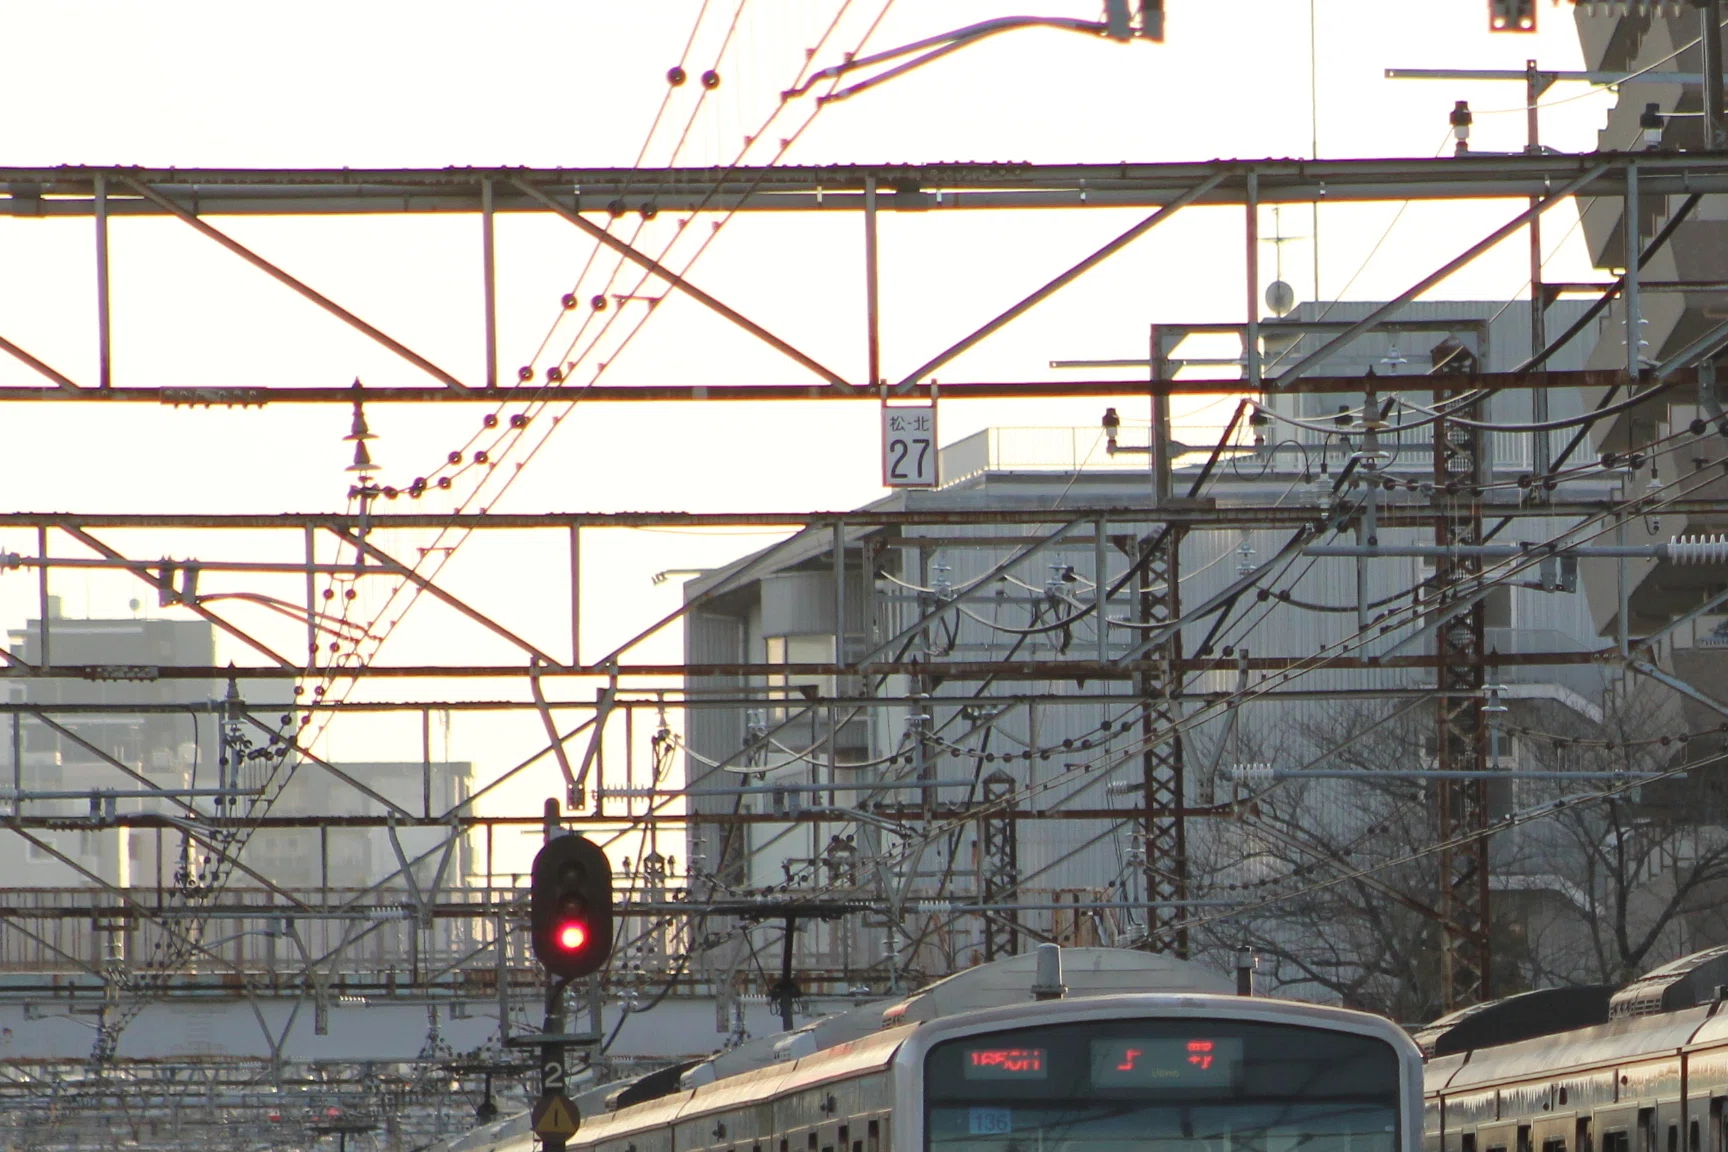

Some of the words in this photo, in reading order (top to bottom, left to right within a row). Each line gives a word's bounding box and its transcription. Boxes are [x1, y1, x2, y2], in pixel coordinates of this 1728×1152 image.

[889, 439, 930, 479] 27
[544, 1061, 563, 1088] 2
[976, 1112, 1010, 1131] 136
